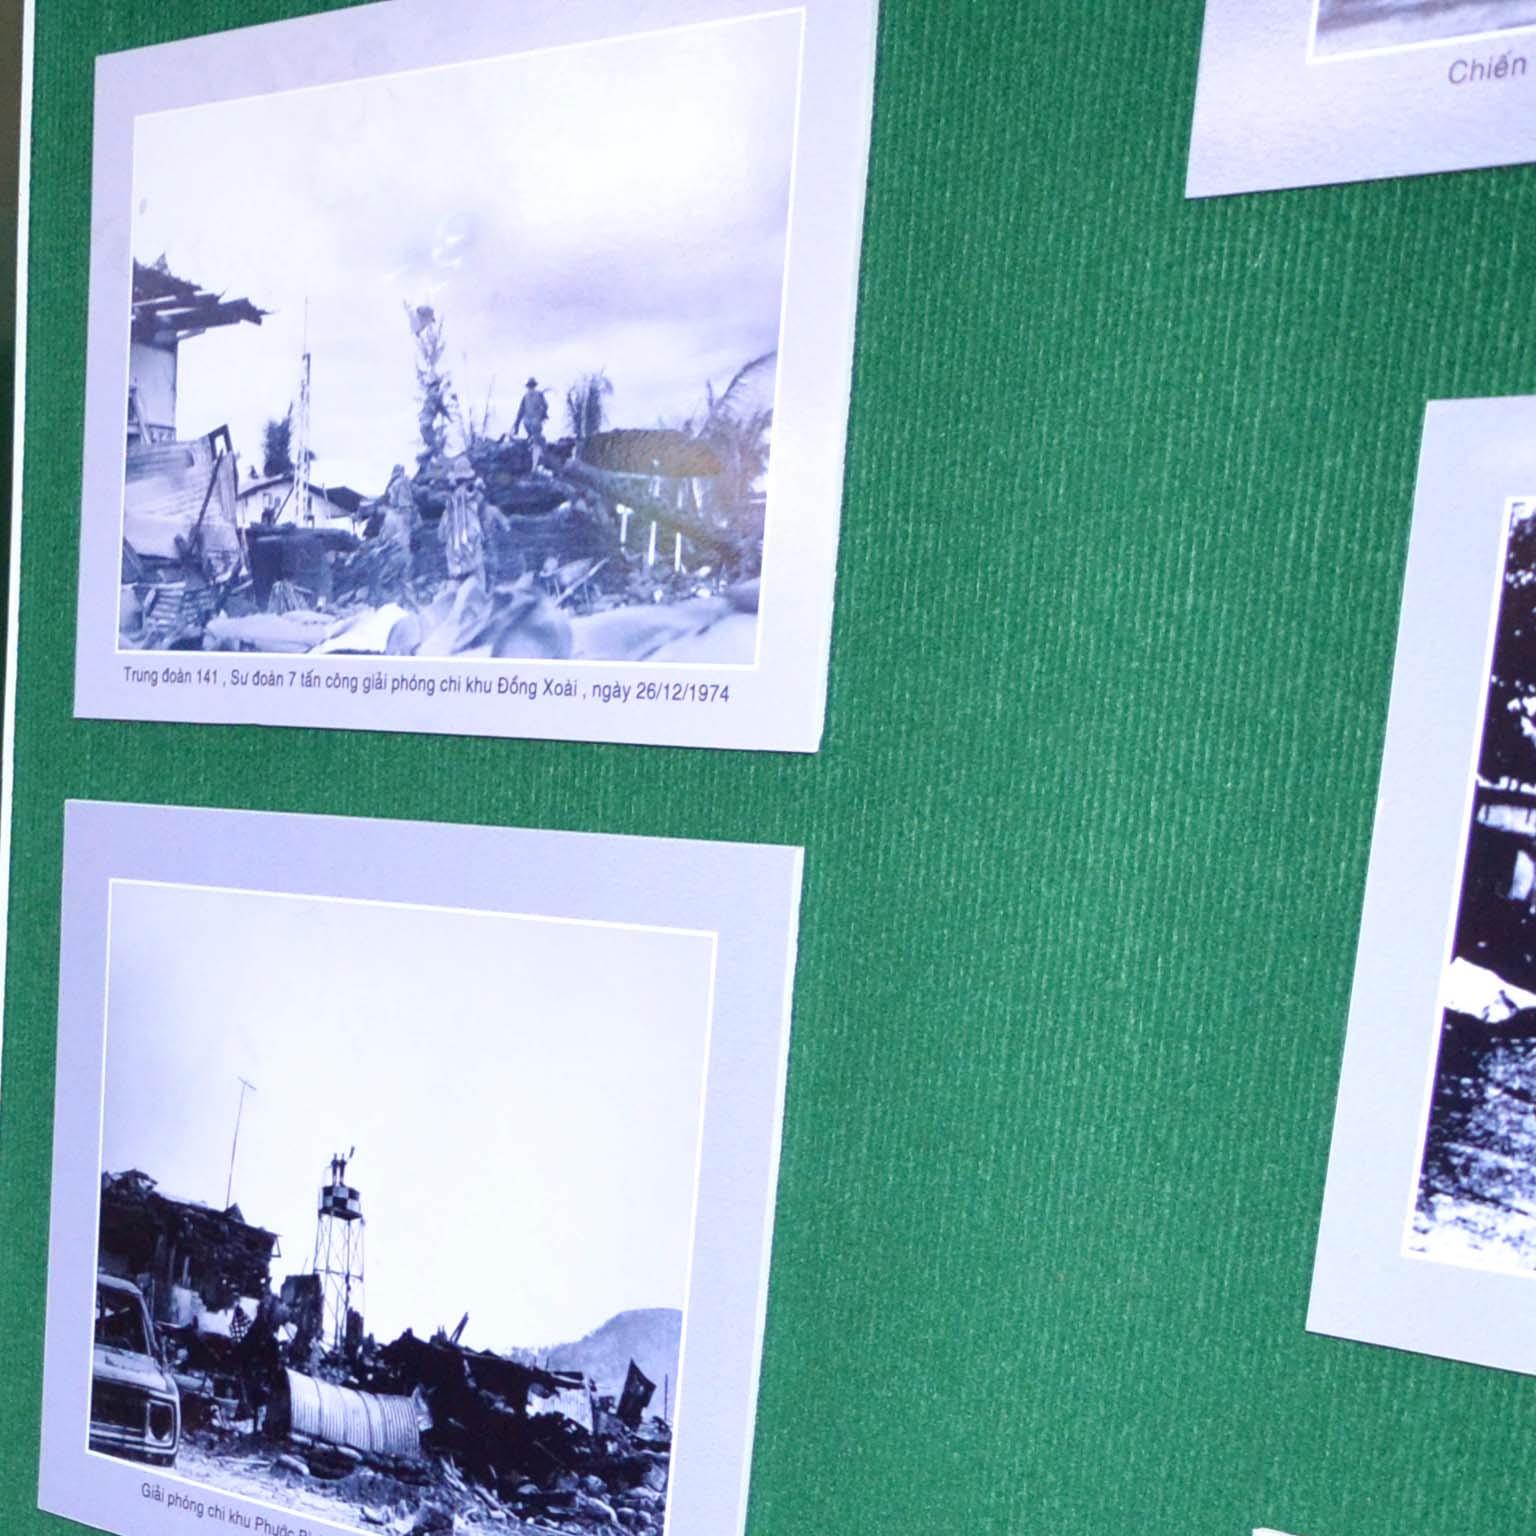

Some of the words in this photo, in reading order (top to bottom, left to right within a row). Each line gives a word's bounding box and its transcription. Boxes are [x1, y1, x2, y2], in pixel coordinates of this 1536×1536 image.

[1447, 49, 1527, 85] Chiến
[123, 666, 158, 687] Trung
[161, 668, 192, 685] đoàn
[196, 669, 218, 685] 141
[231, 670, 249, 686] Sư
[252, 670, 284, 688] đoàn
[288, 672, 295, 687] 7
[301, 669, 321, 688] tấn
[325, 673, 358, 693] công
[362, 671, 388, 693] giải
[391, 675, 436, 696] phóng
[440, 676, 461, 693] chi
[466, 676, 492, 694] khu
[497, 674, 537, 699] Đồng
[543, 678, 578, 697] Xoài
[592, 680, 631, 704] ngày
[635, 682, 730, 703] 26/12/1974
[141, 1482, 165, 1500] Giải
[167, 1493, 205, 1518] phóng
[207, 1503, 226, 1520] chi
[229, 1509, 251, 1529] khu
